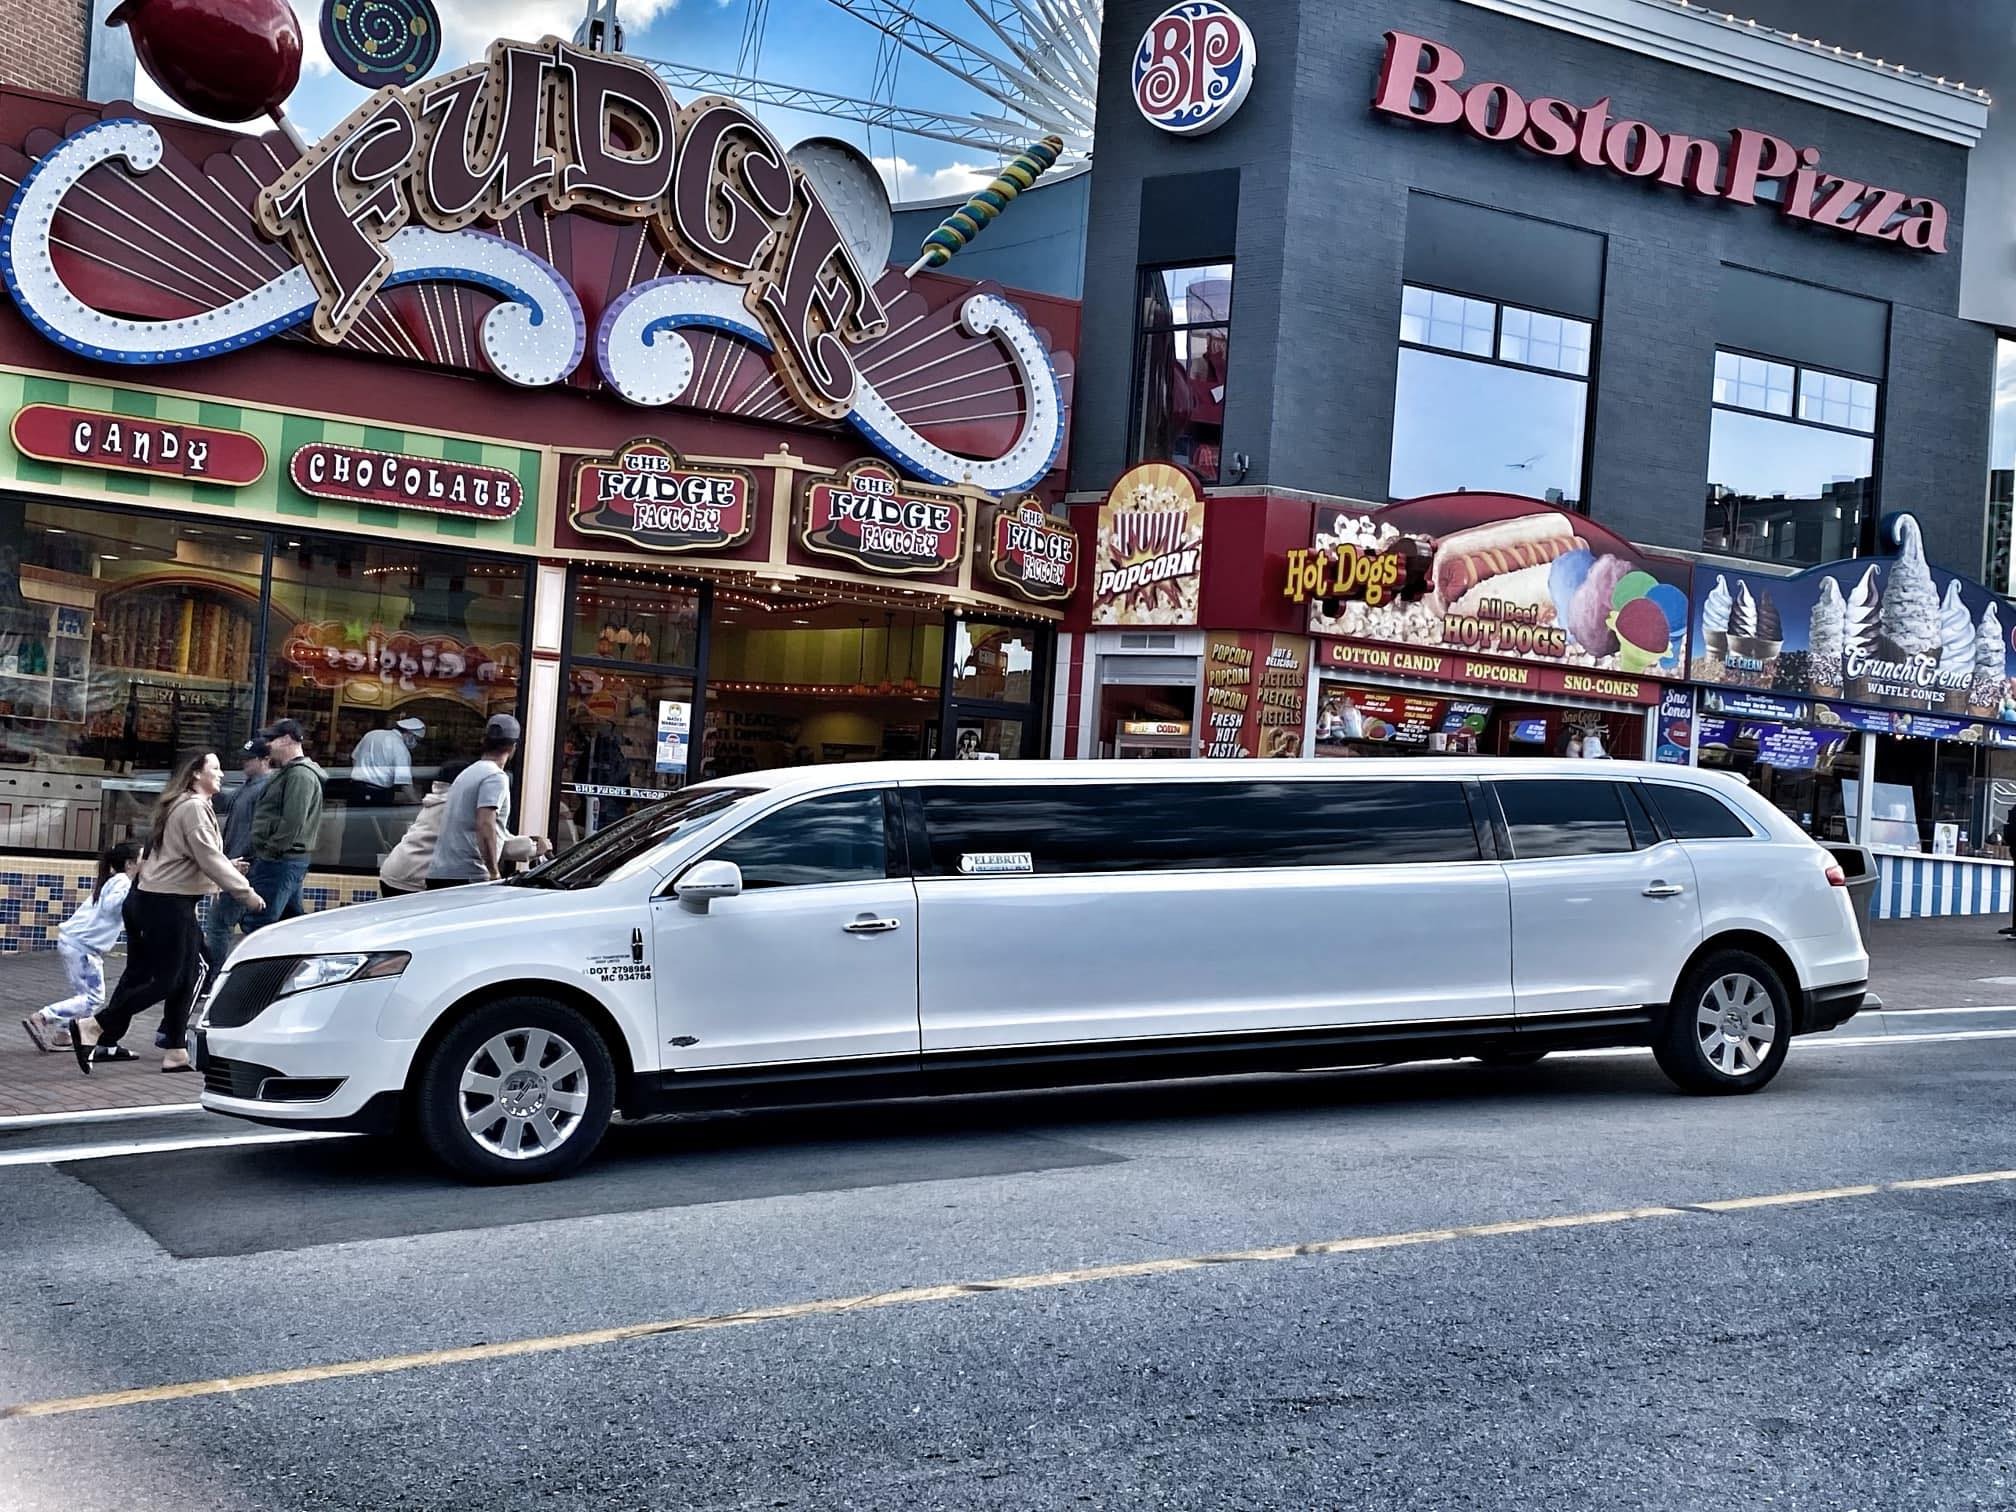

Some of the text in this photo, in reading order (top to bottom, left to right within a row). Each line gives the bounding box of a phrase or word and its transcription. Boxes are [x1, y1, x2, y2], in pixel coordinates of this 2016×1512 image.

[1138, 14, 1241, 116] BP
[264, 36, 889, 410] FUDGE
[73, 421, 208, 473] CANDY
[624, 455, 671, 471] THE
[308, 453, 512, 508] CHOCOLATE
[598, 470, 736, 507] FUDGE
[853, 475, 895, 495] THE
[632, 503, 721, 533] FACTORY
[828, 489, 951, 533] FUDGE
[1021, 507, 1044, 526] THE
[860, 524, 939, 558] FACTORY
[1006, 520, 1073, 563] FUDGE
[1022, 553, 1066, 586] FACTORY
[1097, 548, 1199, 597] POPCORN
[1284, 543, 1398, 605] Hot Dogs
[1478, 598, 1539, 624] All Beef
[1443, 614, 1567, 658] HOT DOGS
[1211, 643, 1254, 667] POPCORN
[1265, 656, 1299, 669] DELICIOUS
[1333, 645, 1442, 674] COTTON CANDY
[1725, 655, 1763, 671] ICE CREAM
[1209, 667, 1251, 686] POPCORN
[1258, 672, 1304, 687] PRETZELS
[1465, 662, 1529, 685] POPCORN
[1563, 674, 1640, 698] SNO-CONES
[1665, 688, 1688, 705] Sno
[1867, 682, 1946, 703] WAFFLE CONES
[1206, 686, 1249, 711] POPCORN
[1256, 687, 1303, 710] PRETZELS
[1660, 701, 1692, 718] Cones
[1210, 712, 1244, 727] FRESH
[1256, 710, 1302, 725] PRETZELS
[1215, 728, 1238, 743] HOT
[1207, 743, 1241, 758] TASTY
[589, 967, 609, 975] DOT
[601, 972, 652, 983] MC 934768
